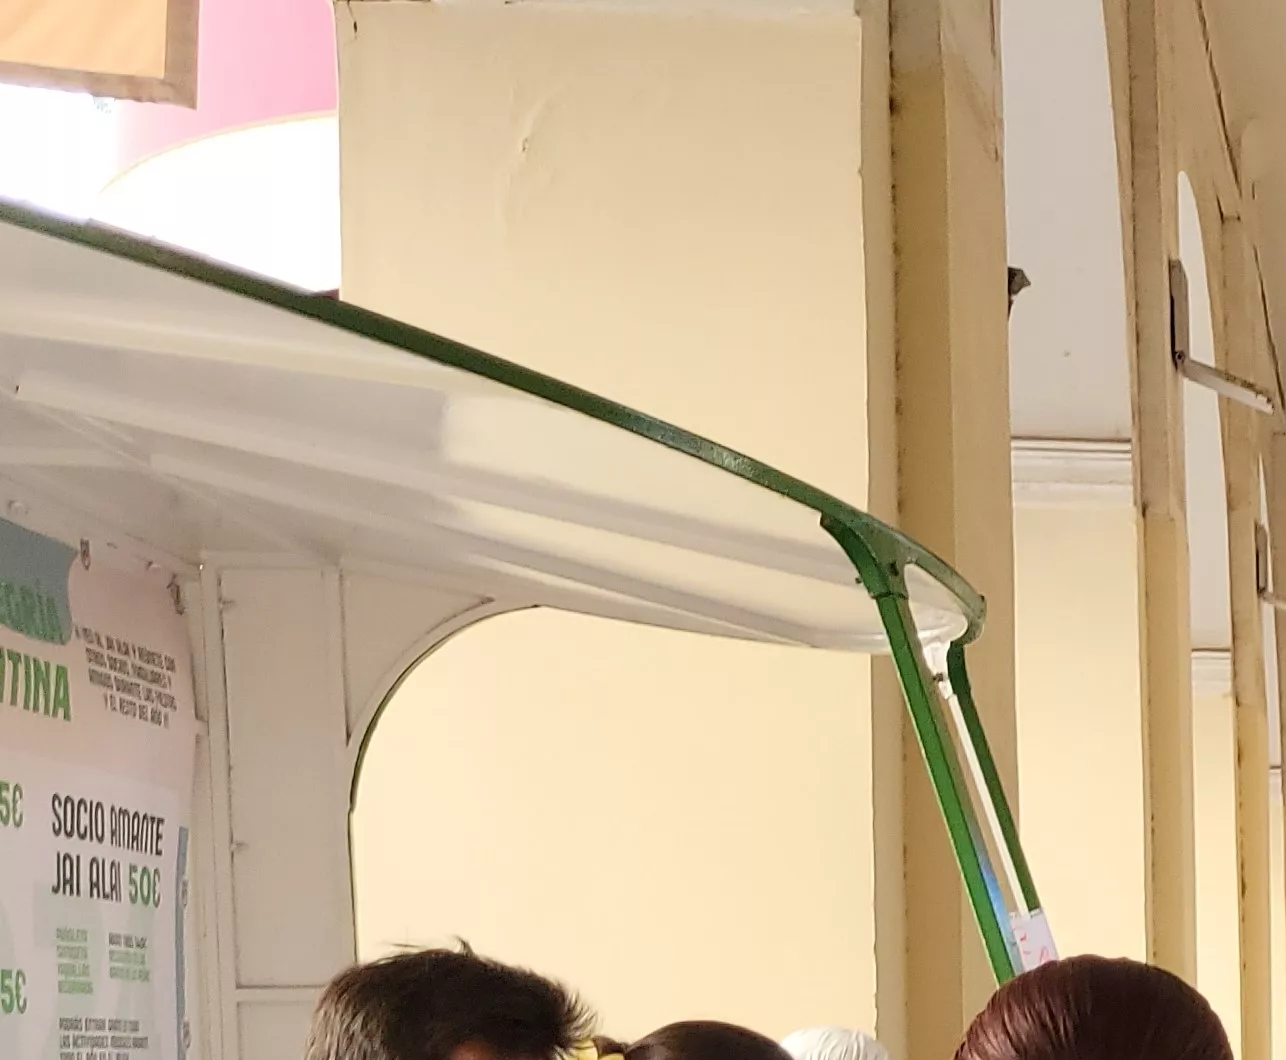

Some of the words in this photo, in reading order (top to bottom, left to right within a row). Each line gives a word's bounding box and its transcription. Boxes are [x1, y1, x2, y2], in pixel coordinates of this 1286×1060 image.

[51, 792, 105, 844] SOCIO
[110, 804, 165, 856] AMANTE
[51, 851, 81, 897] JAI
[89, 856, 122, 903] ALAI
[128, 863, 161, 909] 50€
